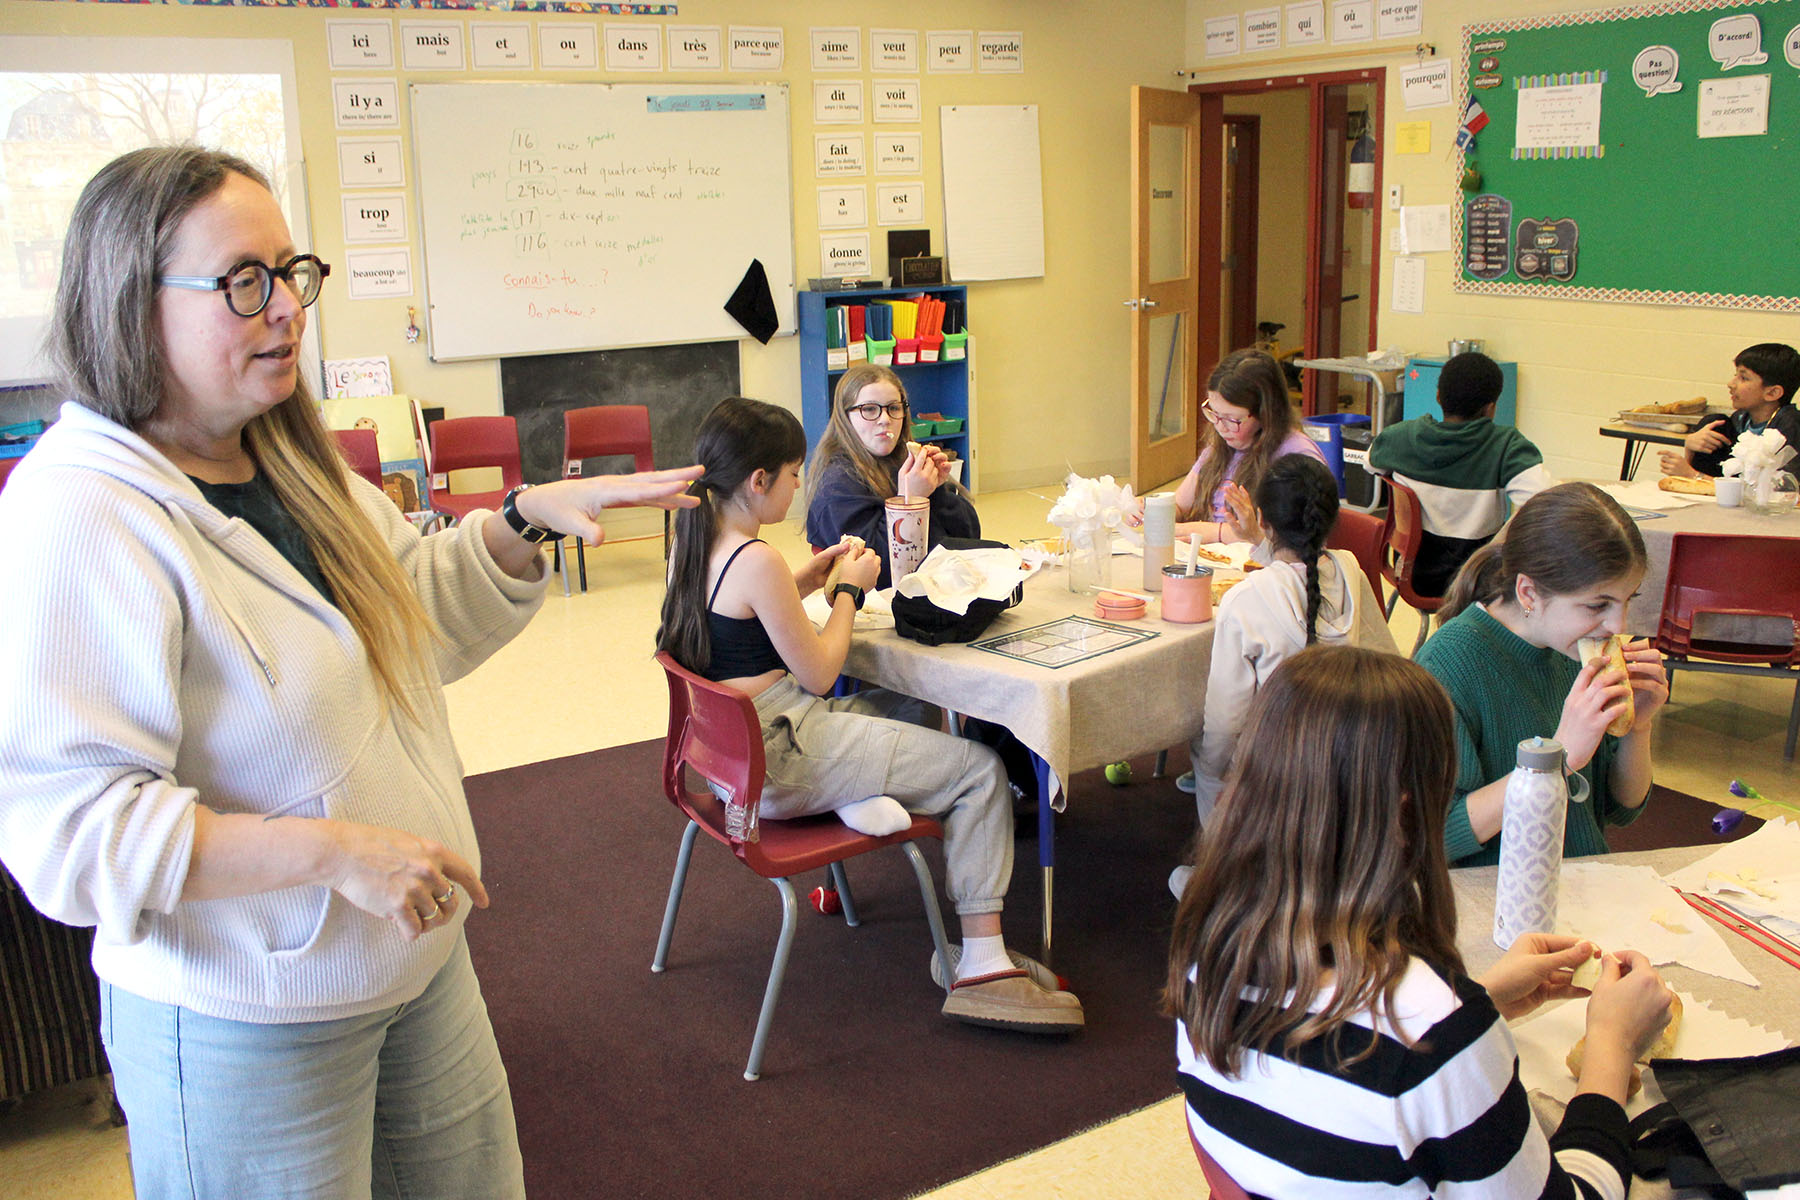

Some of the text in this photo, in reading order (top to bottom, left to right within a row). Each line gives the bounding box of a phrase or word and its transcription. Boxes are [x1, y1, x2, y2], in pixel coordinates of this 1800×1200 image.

[1343, 9, 1356, 22] où
[1381, 4, 1418, 16] est-ce que
[1247, 20, 1278, 33] combien
[1298, 17, 1312, 32] qui
[352, 34, 370, 48] ici
[416, 33, 450, 46] mais
[1718, 31, 1753, 42] D'accord!
[495, 38, 508, 49] et
[560, 40, 576, 50] ou
[618, 39, 648, 51] dans
[683, 38, 707, 52] très
[734, 39, 780, 51] parce que
[821, 41, 849, 52] aime
[883, 42, 906, 52] veut
[981, 41, 1019, 55] regarde
[939, 45, 961, 58] peut
[1649, 60, 1662, 68] Pas
[1405, 69, 1447, 89] pourquoi
[1638, 68, 1672, 80] question!
[831, 89, 846, 101] dit
[886, 88, 906, 100] voit
[349, 94, 383, 110] il y a
[518, 134, 534, 149] 16
[830, 144, 848, 156] fait
[892, 143, 905, 153] va
[363, 151, 376, 164] si
[688, 158, 721, 176] treize
[839, 198, 846, 207] a
[893, 193, 908, 204] est
[360, 206, 390, 221] trop
[519, 209, 534, 227] 17
[522, 232, 547, 253] 116
[829, 247, 862, 259] donne
[353, 267, 395, 279] beaucoup
